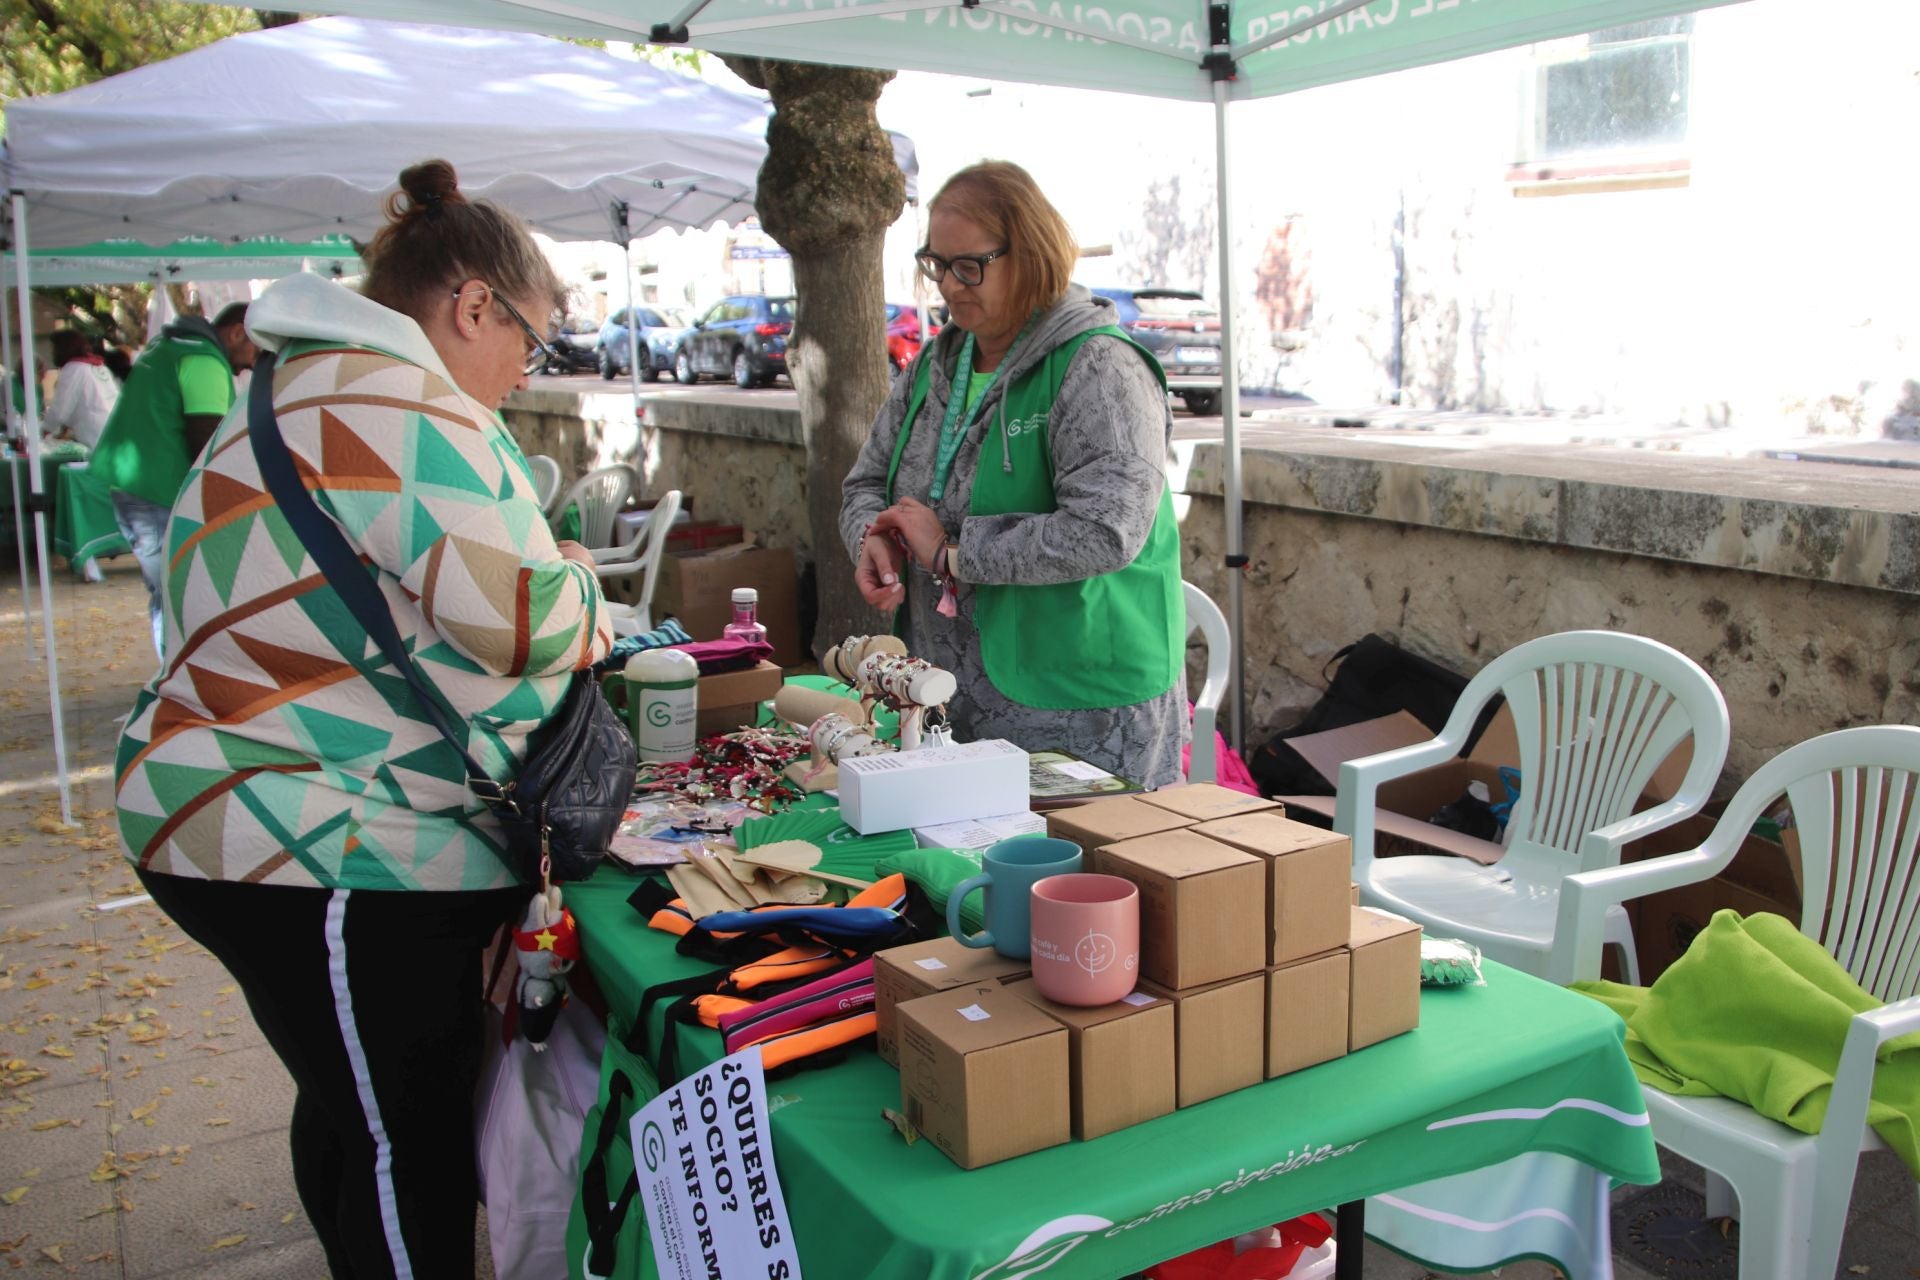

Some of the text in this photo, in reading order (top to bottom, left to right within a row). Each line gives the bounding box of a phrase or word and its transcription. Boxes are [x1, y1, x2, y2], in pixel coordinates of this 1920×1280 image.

[668, 1088, 688, 1136] TE
[694, 1073, 738, 1212] SOCIO?
[720, 1062, 780, 1249] ¿QUIERES
[653, 1184, 674, 1259] en Segovia
[658, 1179, 673, 1224] contra
[670, 1226, 678, 1240] el
